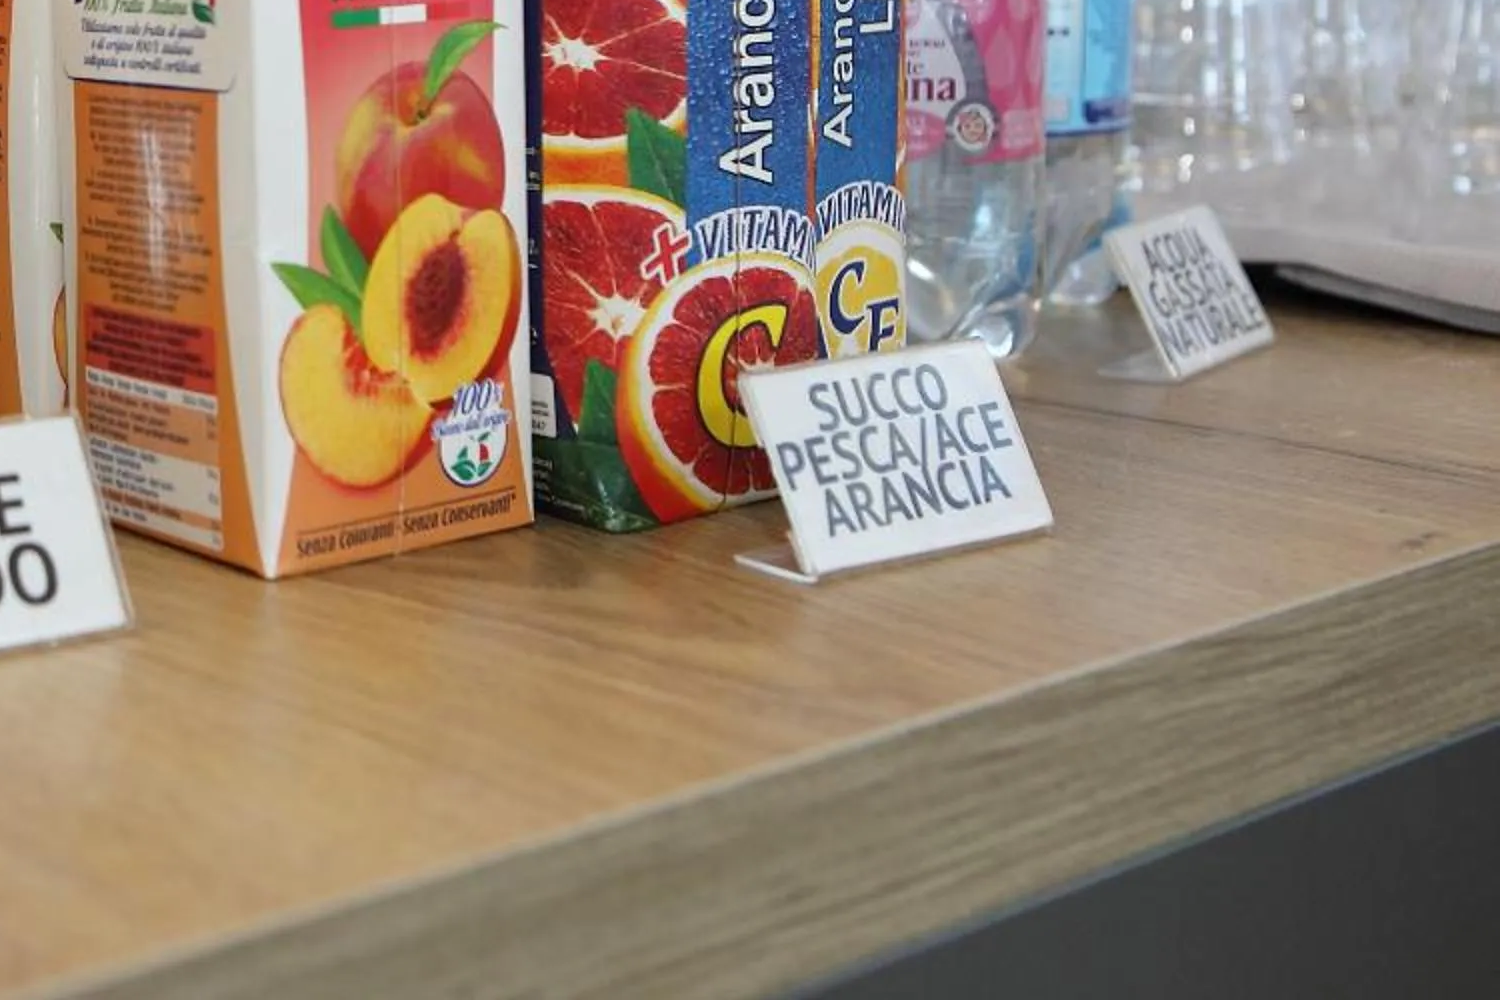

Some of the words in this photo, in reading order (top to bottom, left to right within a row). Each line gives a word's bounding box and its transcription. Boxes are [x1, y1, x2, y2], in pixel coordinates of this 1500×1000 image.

[807, 364, 948, 431] SUCCO
[776, 401, 1013, 491] PESCA/ACE
[823, 455, 1013, 537] ARANCIA
